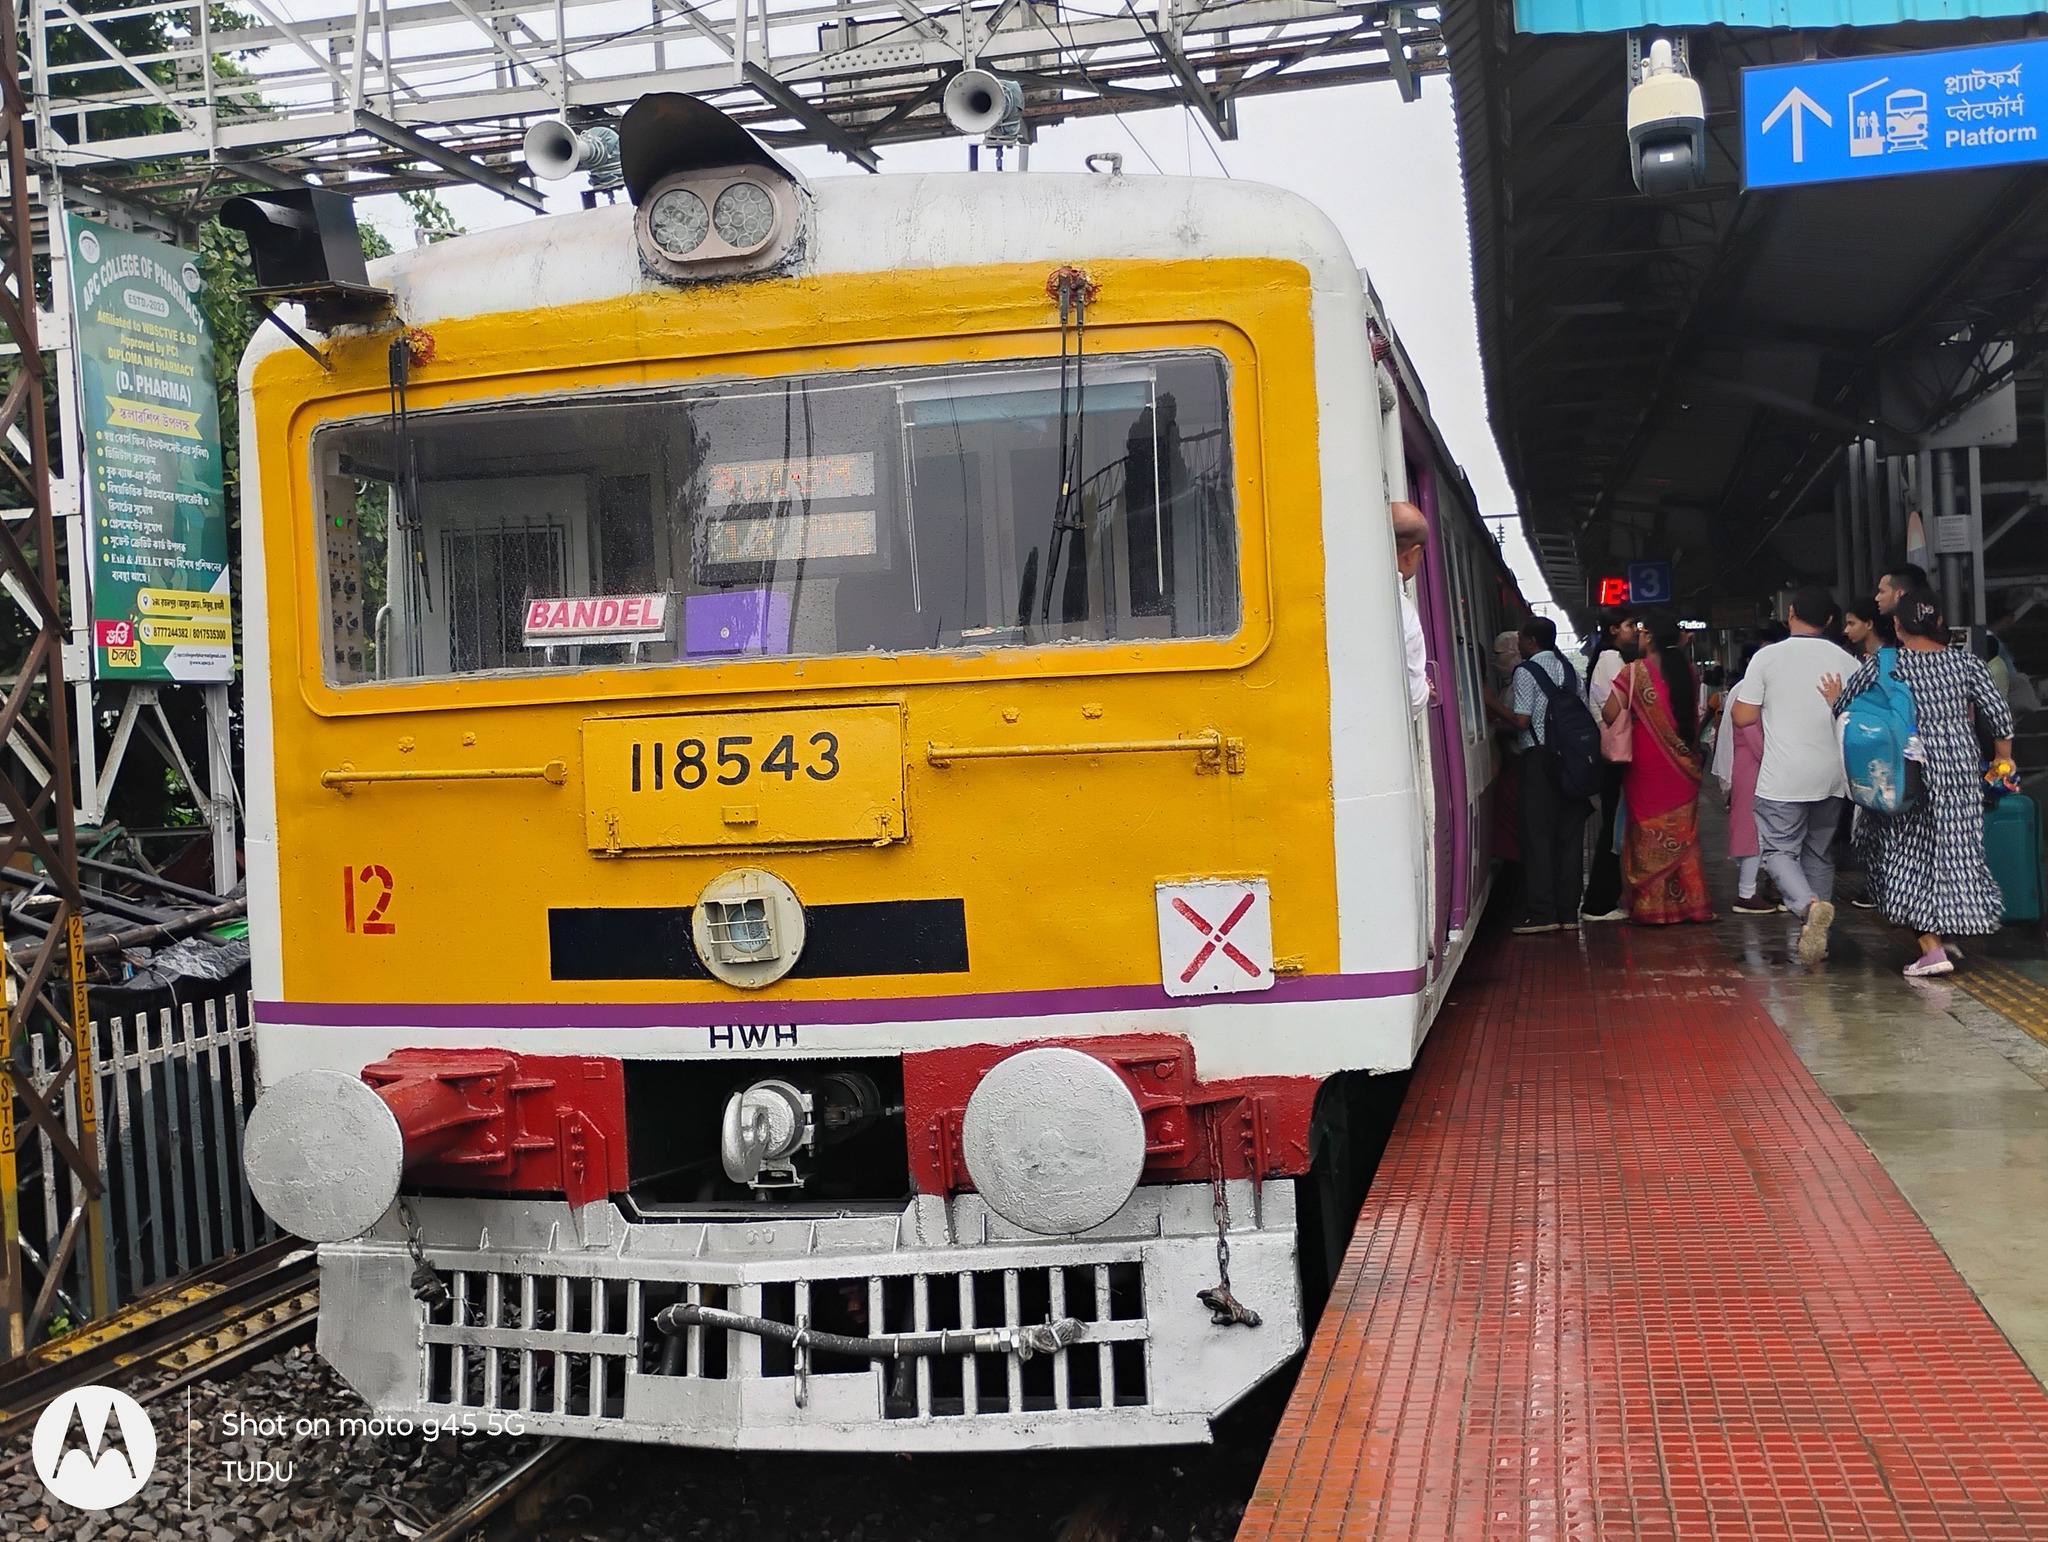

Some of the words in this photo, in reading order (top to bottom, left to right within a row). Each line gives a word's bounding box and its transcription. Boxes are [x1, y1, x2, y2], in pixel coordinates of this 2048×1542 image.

[1944, 93, 2024, 121] प्लेटफॉर्म
[1945, 126, 2037, 148] Platform
[83, 272, 100, 312] APC
[101, 254, 140, 288] COLLEGE
[141, 256, 153, 280] OF
[154, 263, 204, 334] PHARMACY
[98, 310, 131, 330] Affiliated
[133, 319, 141, 332] to
[142, 321, 178, 341] WBSCTVE
[180, 332, 186, 344] &
[187, 333, 197, 346] SD
[120, 333, 155, 352] Approved
[155, 342, 164, 357] by
[166, 344, 179, 358] PCI
[108, 347, 143, 366] DIPLOMA
[144, 355, 152, 368] IN
[154, 357, 195, 377] PHARMACY
[116, 370, 133, 393] (D.
[135, 374, 191, 408] PHARMA)
[126, 555, 133, 564] &
[1639, 568, 1661, 598] 3
[527, 597, 661, 629] BANDEL
[106, 622, 130, 645] ভর্তি
[112, 648, 137, 666] চলছে
[631, 731, 840, 792] 118543
[343, 864, 396, 935] 12
[708, 1023, 798, 1049] HWH
